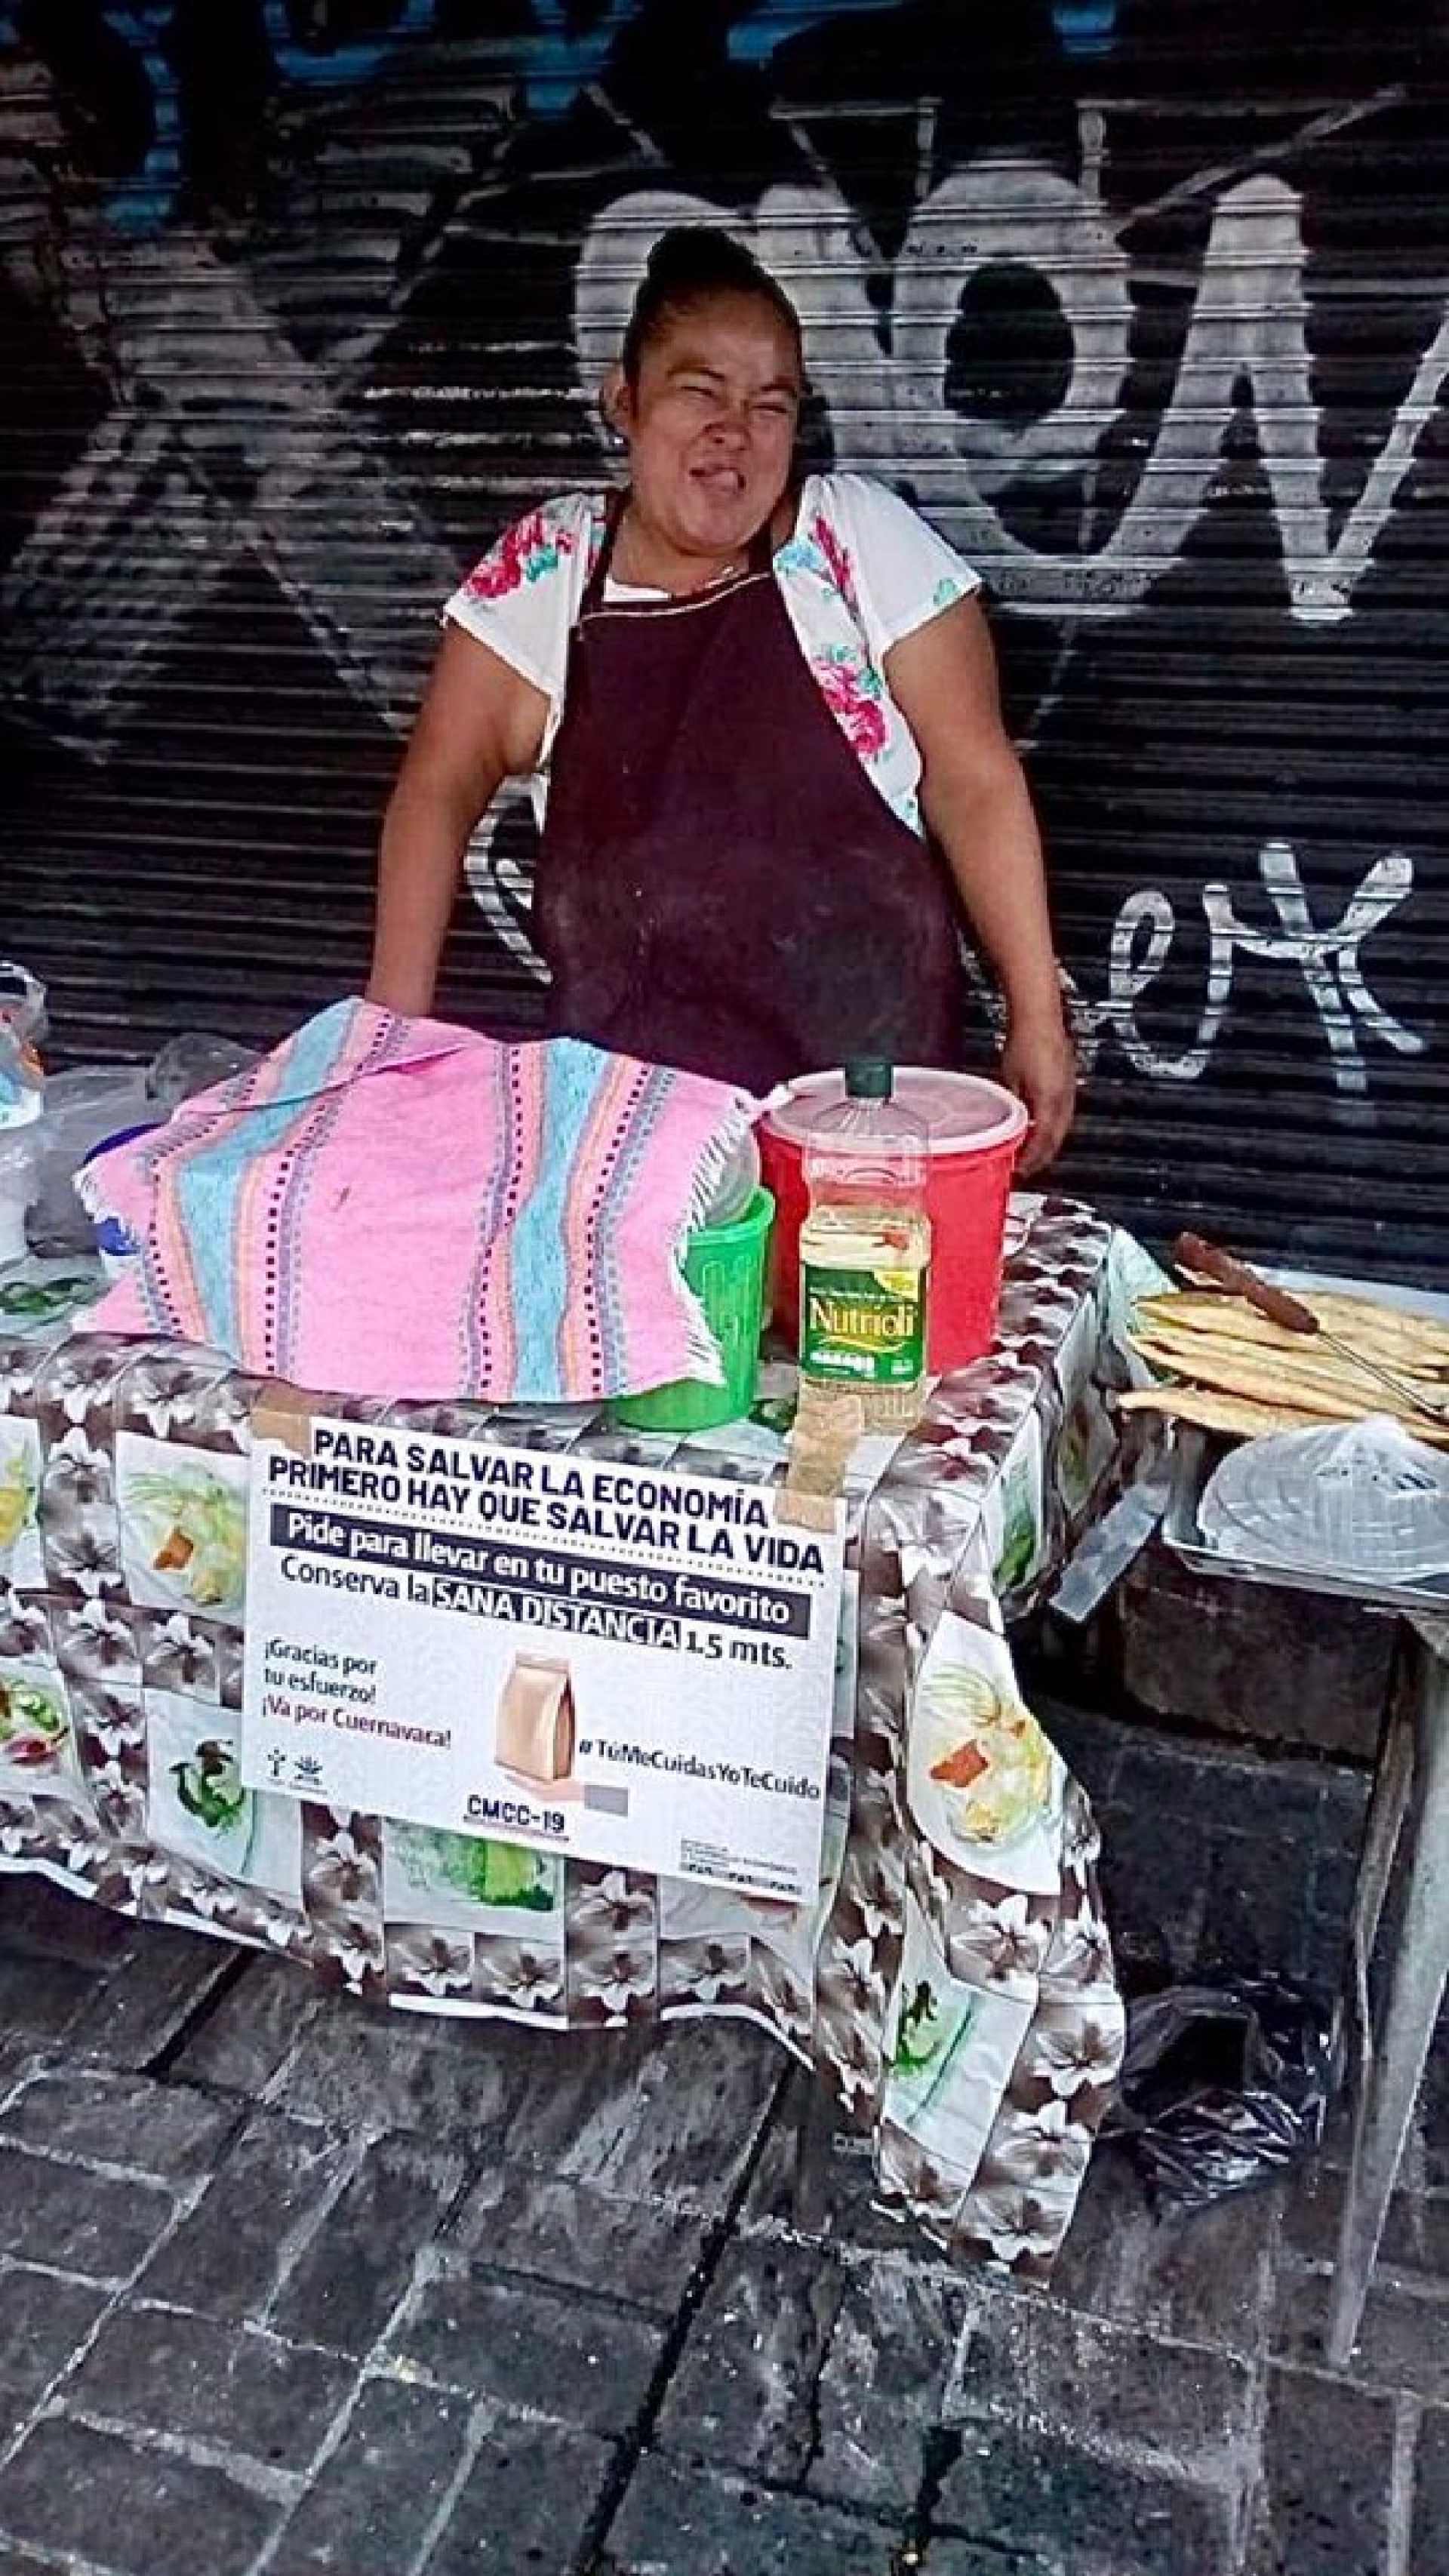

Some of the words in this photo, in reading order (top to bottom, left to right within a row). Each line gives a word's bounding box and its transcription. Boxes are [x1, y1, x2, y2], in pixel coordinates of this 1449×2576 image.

[809, 1297, 915, 1337] Nutrioli
[314, 1429, 398, 1469] PARA
[406, 1442, 532, 1490] SALVAR
[541, 1465, 584, 1499] LA
[593, 1473, 768, 1529] ECONOMÍA
[269, 1455, 401, 1502] PRIMERO
[408, 1477, 470, 1514] HAY
[478, 1490, 540, 1526] QUE
[546, 1501, 679, 1550] SALVAR
[688, 1524, 734, 1559] LA
[744, 1534, 824, 1574] VIDA
[288, 1512, 345, 1547] Pide
[349, 1529, 410, 1559] para
[414, 1532, 489, 1572] llevar
[493, 1552, 528, 1579] en
[534, 1557, 565, 1583] tu
[570, 1567, 668, 1602] puesto
[675, 1576, 790, 1625] favorito
[281, 1553, 401, 1600] Conserva
[408, 1572, 430, 1603] la
[435, 1580, 515, 1621] SANA
[521, 1596, 679, 1649] DISTANCIA
[686, 1630, 723, 1660] 1.5
[728, 1639, 794, 1670] mts.
[265, 1638, 339, 1670] ¡Gracias
[343, 1655, 377, 1677] por
[264, 1668, 285, 1685] tu
[288, 1670, 377, 1705] esfuerzo!
[263, 1694, 291, 1718] ¡Va
[294, 1703, 328, 1726] por
[332, 1706, 452, 1750] Cuernavaca!
[466, 1793, 565, 1834] CMCC-19
